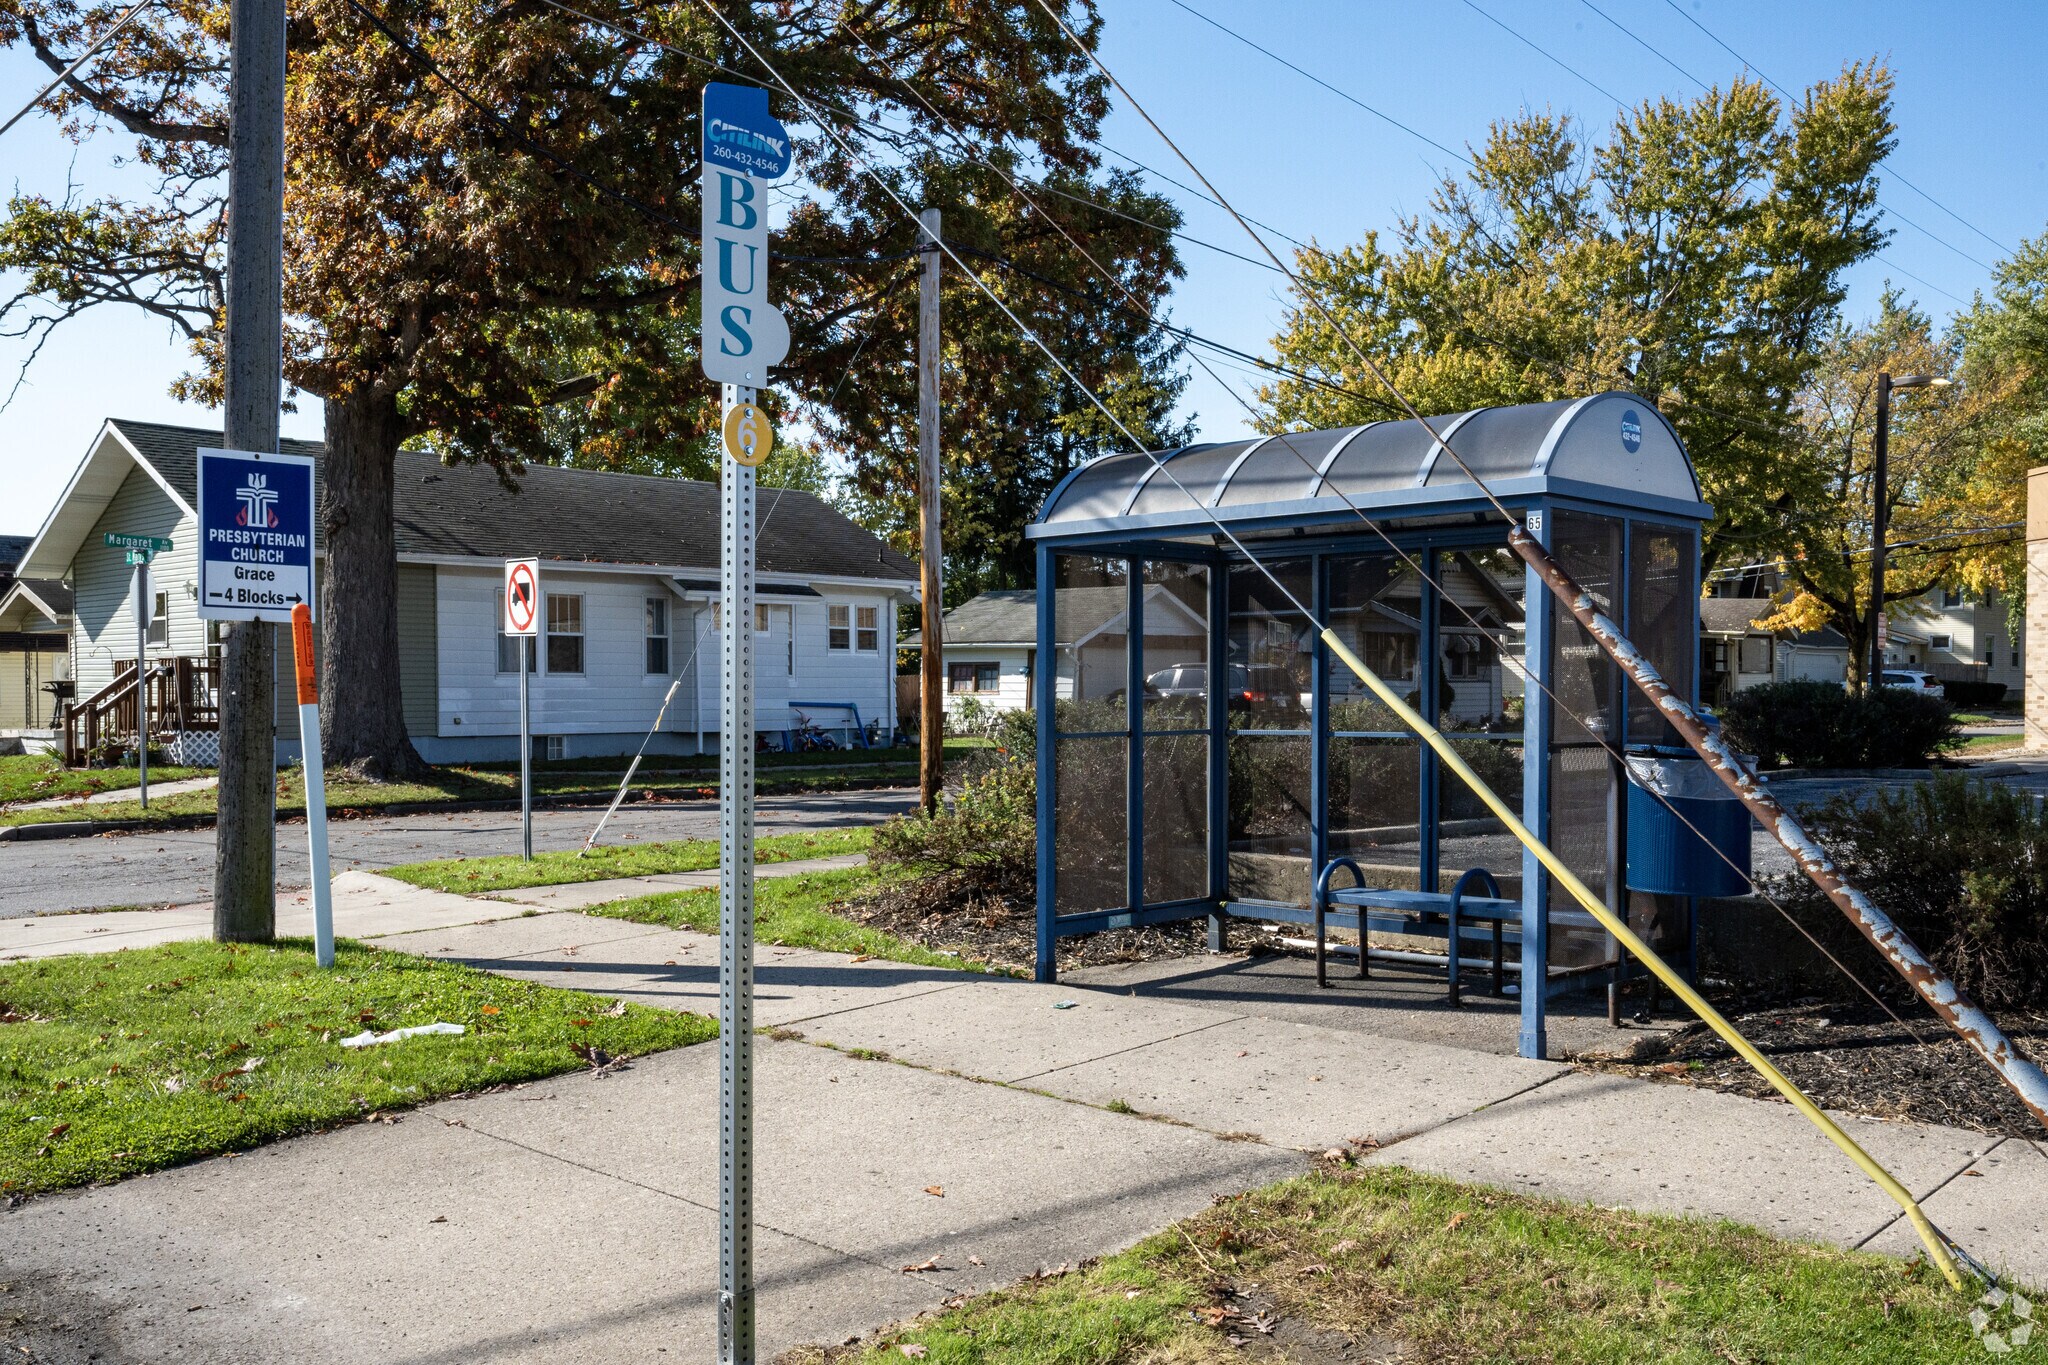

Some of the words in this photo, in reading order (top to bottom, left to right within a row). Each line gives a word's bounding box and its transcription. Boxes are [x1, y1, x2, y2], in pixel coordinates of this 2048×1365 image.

[707, 118, 784, 158] CITILINK
[713, 145, 779, 173] 260-432-4546
[714, 171, 759, 357] BUS
[737, 417, 758, 453] 6
[1528, 517, 1541, 530] 65
[108, 534, 153, 548] Margaret
[209, 528, 306, 547] PRESBYTERIAN
[231, 547, 284, 563] CHURCH
[234, 565, 275, 581] Grace
[224, 587, 234, 602] 4
[237, 588, 285, 604] Blocks
